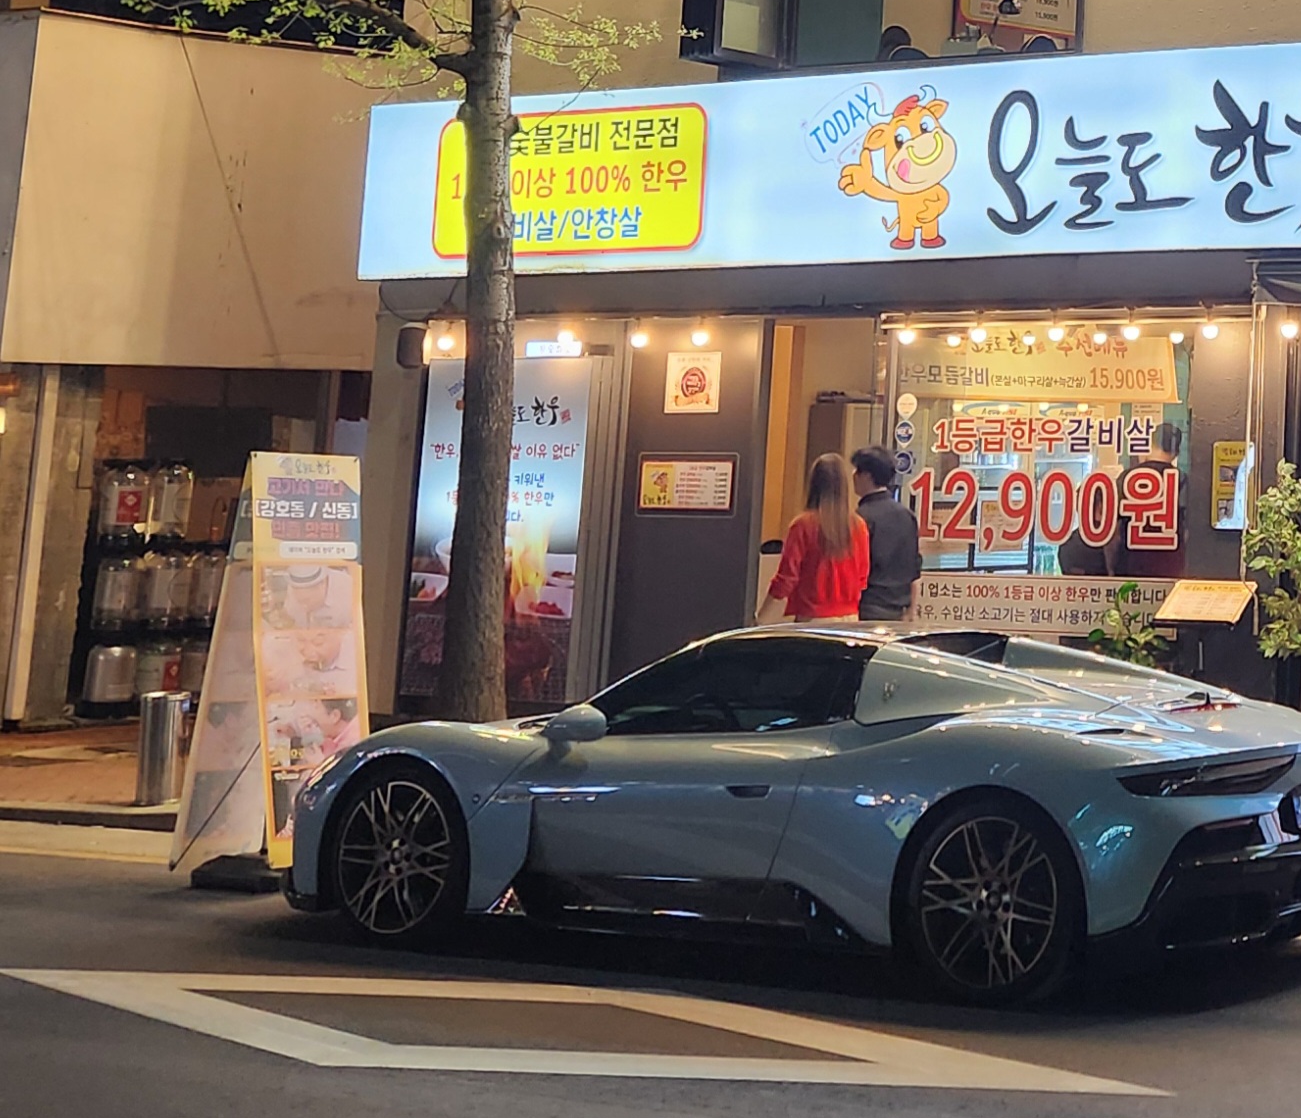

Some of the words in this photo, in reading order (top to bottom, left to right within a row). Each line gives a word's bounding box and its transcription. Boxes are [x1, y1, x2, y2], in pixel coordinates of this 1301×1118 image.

[609, 116, 679, 151] 전문점
[808, 85, 876, 155] TODAY
[511, 167, 556, 199] 이상
[565, 164, 631, 196] 100%
[641, 159, 688, 194] 한우
[986, 89, 1195, 235] 오늘도
[512, 206, 642, 243] 비살/안창살
[531, 395, 560, 426] 한우
[526, 443, 547, 458] 이유
[935, 416, 1155, 454] 1등급한우갈비살
[910, 469, 1179, 550] 12,900원
[928, 584, 963, 598] 업소는
[966, 584, 1000, 599] 100%
[1004, 585, 1035, 601] 1등급
[1038, 585, 1062, 602] 이상
[1066, 585, 1102, 604] 한우만
[1105, 587, 1169, 605] 판합니다
[941, 605, 975, 622] 수입산
[979, 607, 1026, 623] 소고기는
[1030, 608, 1052, 624] 절대
